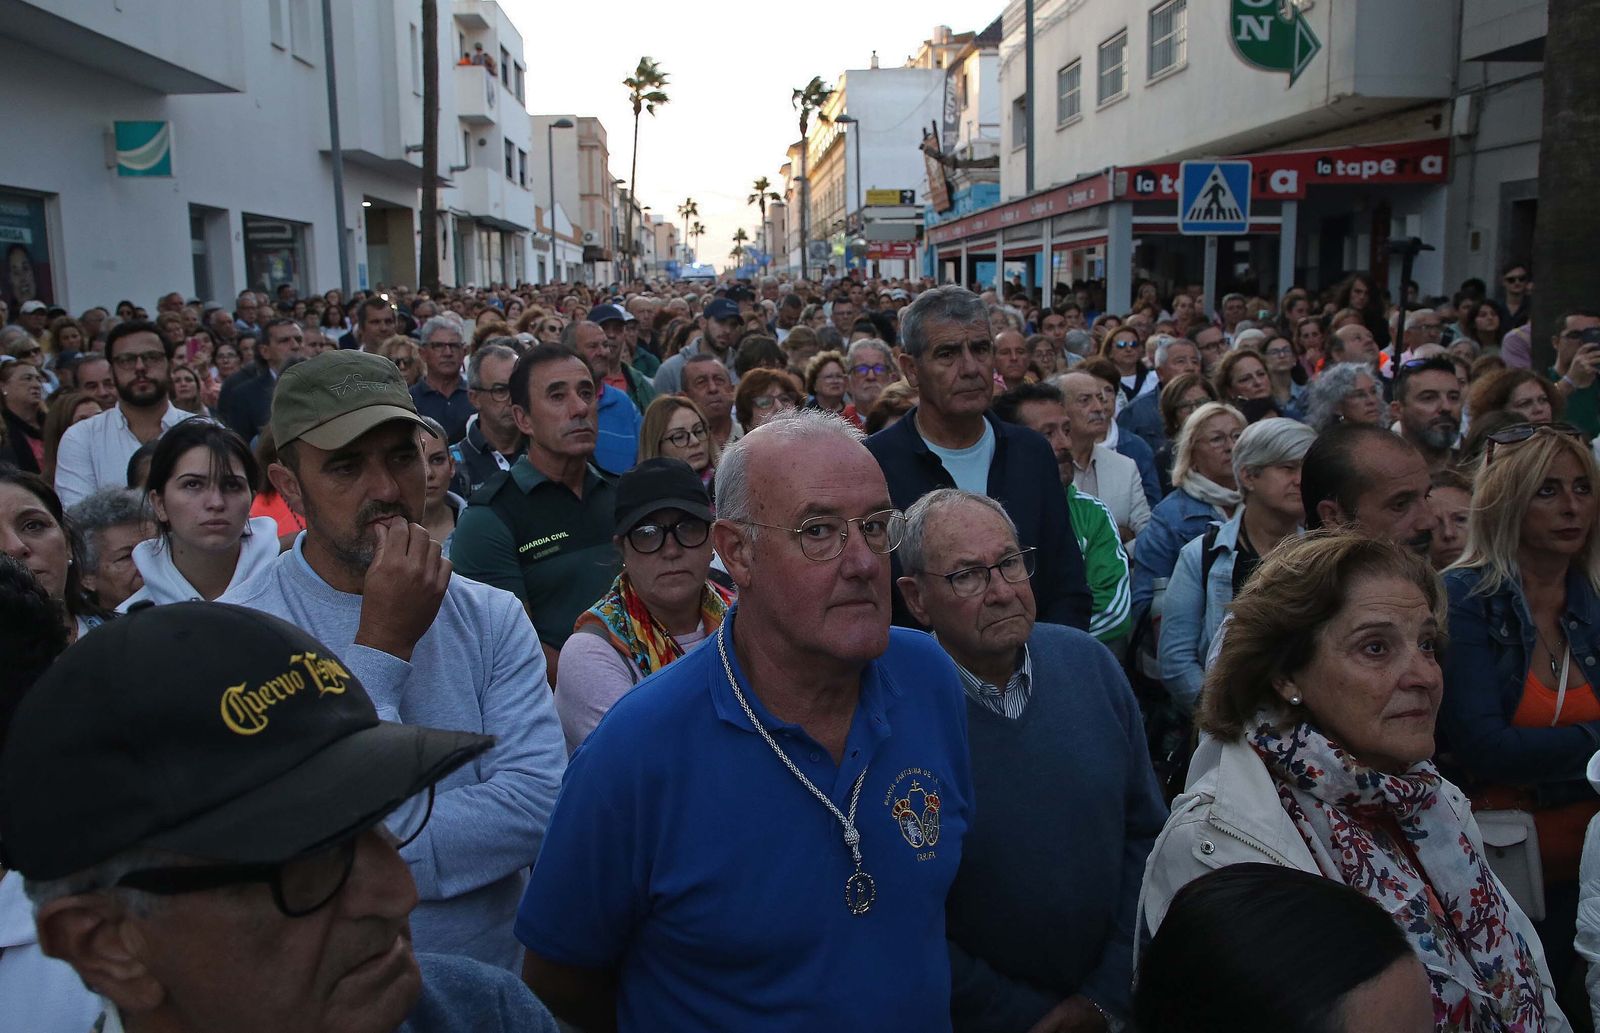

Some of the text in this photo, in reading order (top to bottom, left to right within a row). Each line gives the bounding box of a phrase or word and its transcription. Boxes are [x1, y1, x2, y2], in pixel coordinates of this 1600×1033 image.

[1317, 159, 1332, 175] la
[1136, 174, 1155, 193] la
[518, 536, 551, 553] GUARDIA
[551, 531, 570, 541] CIVIL
[219, 681, 305, 736] Cuervo
